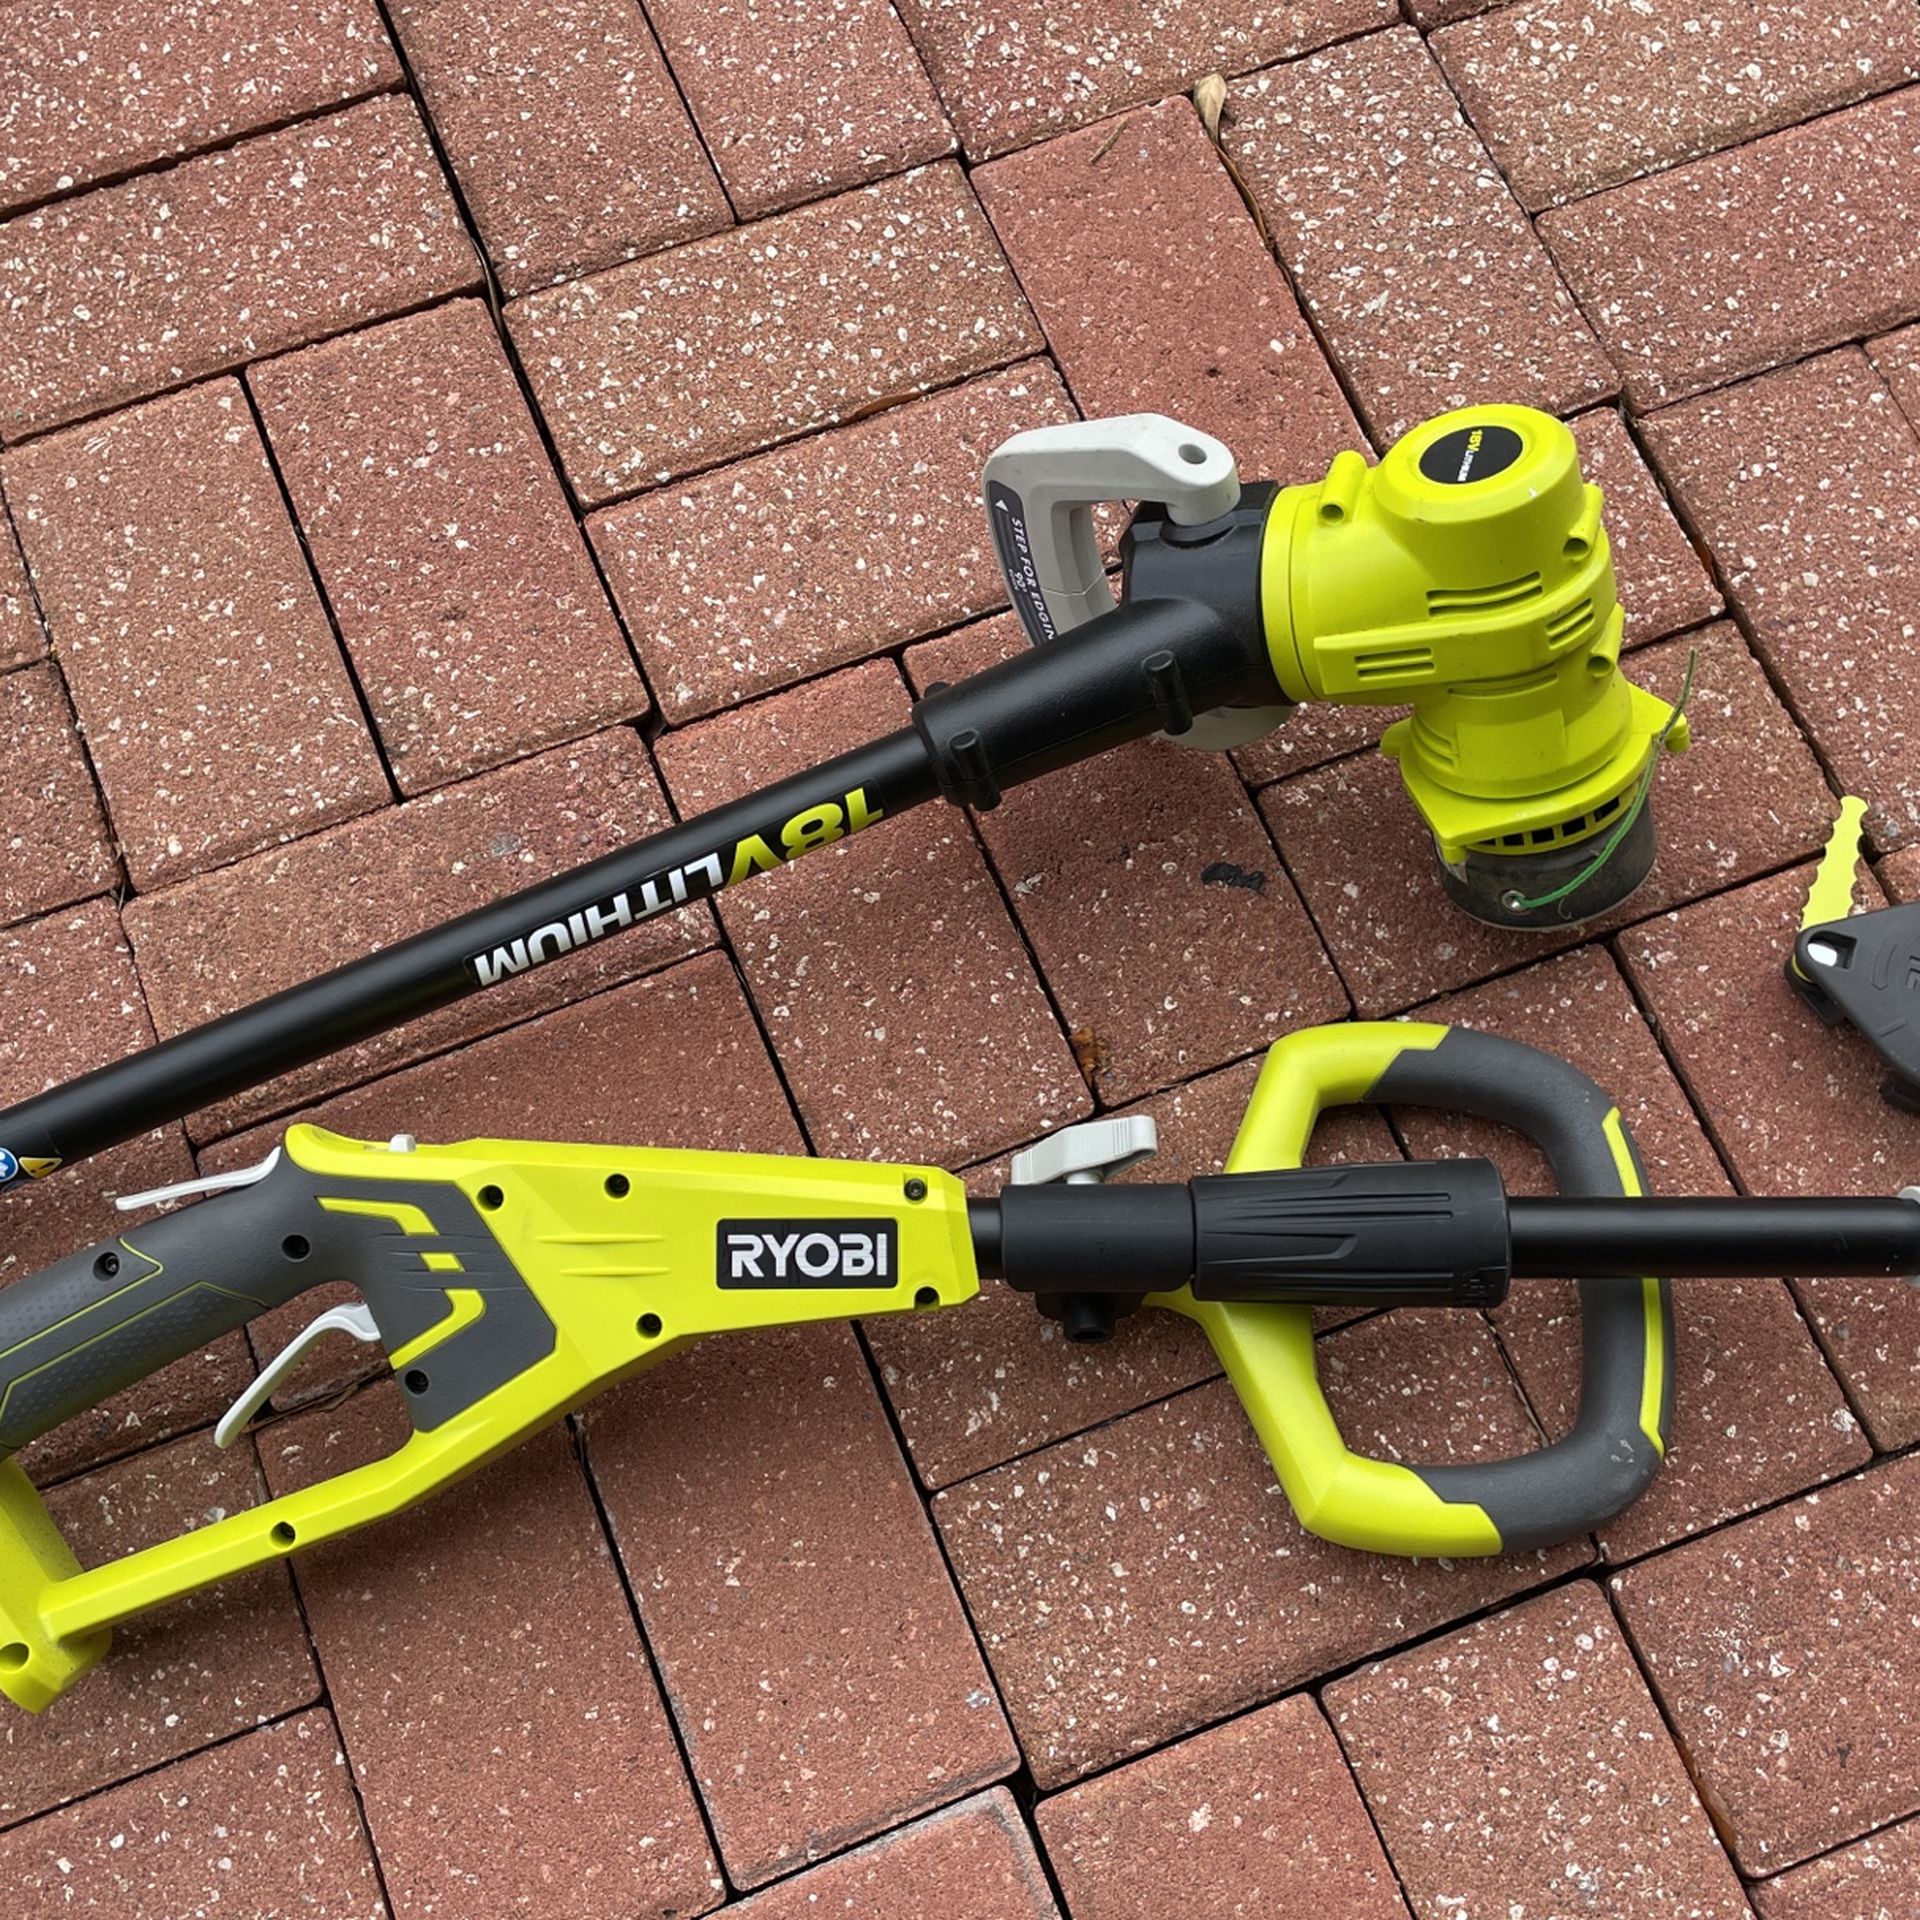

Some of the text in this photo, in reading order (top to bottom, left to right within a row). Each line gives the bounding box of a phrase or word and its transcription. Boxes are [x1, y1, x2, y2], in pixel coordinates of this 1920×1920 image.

[1012, 517, 1027, 553] STEP
[1020, 556, 1036, 587] FOR
[473, 852, 723, 987] LITHIUM
[727, 1232, 888, 1278] RYOBI
